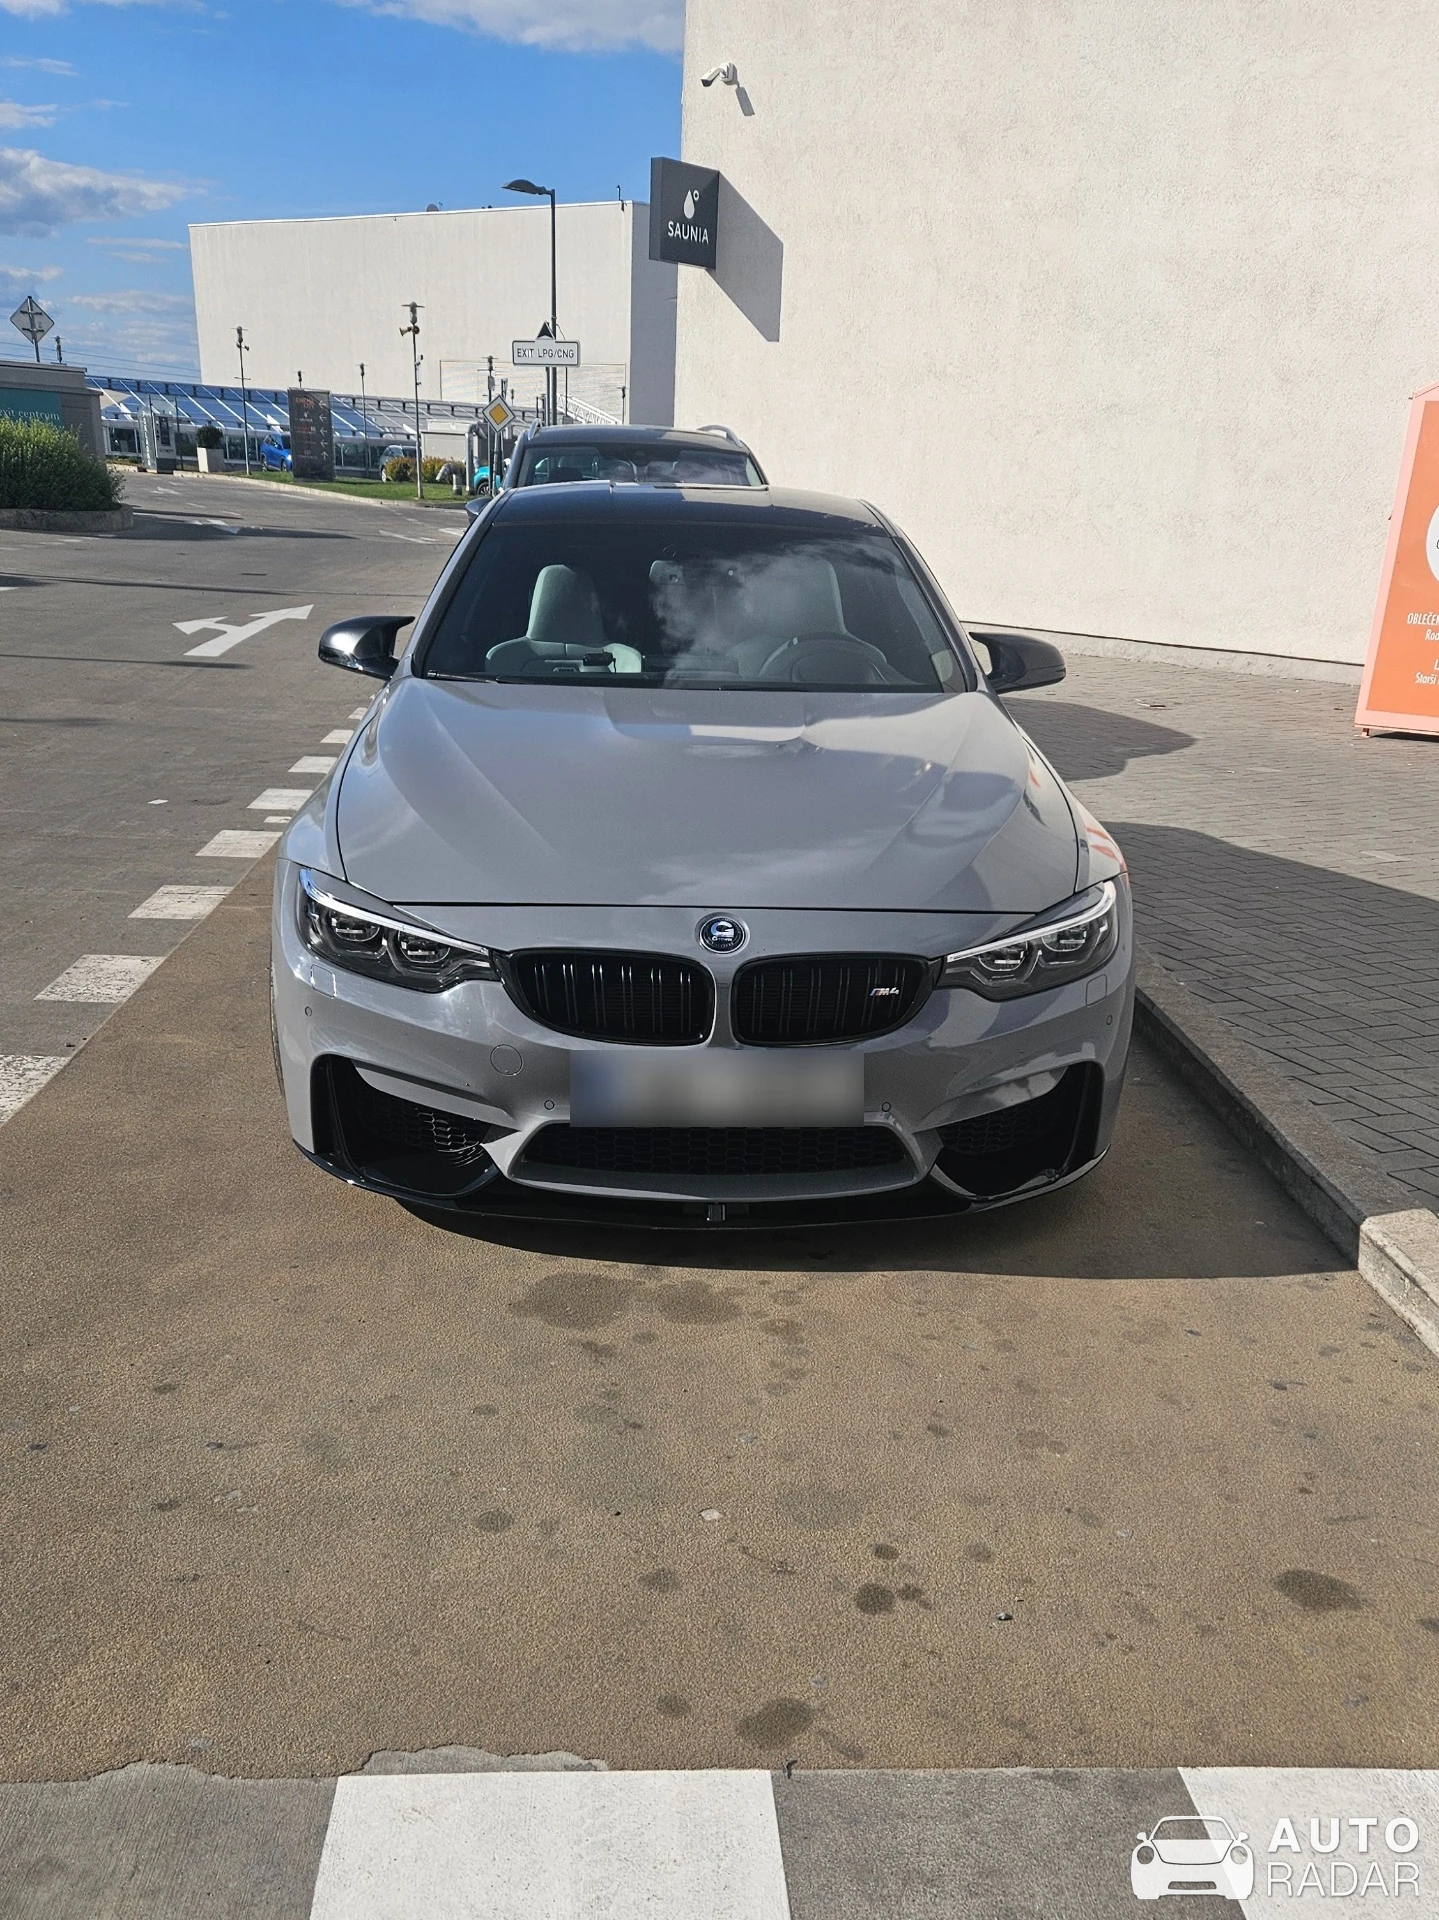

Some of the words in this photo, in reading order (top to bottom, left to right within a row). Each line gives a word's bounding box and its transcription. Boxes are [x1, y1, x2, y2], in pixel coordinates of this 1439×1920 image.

[668, 220, 709, 244] SAUNIA
[517, 348, 534, 358] EXIT
[538, 348, 574, 358] LPG/CNG
[18, 410, 60, 421] centrum
[1415, 672, 1437, 685] Starší
